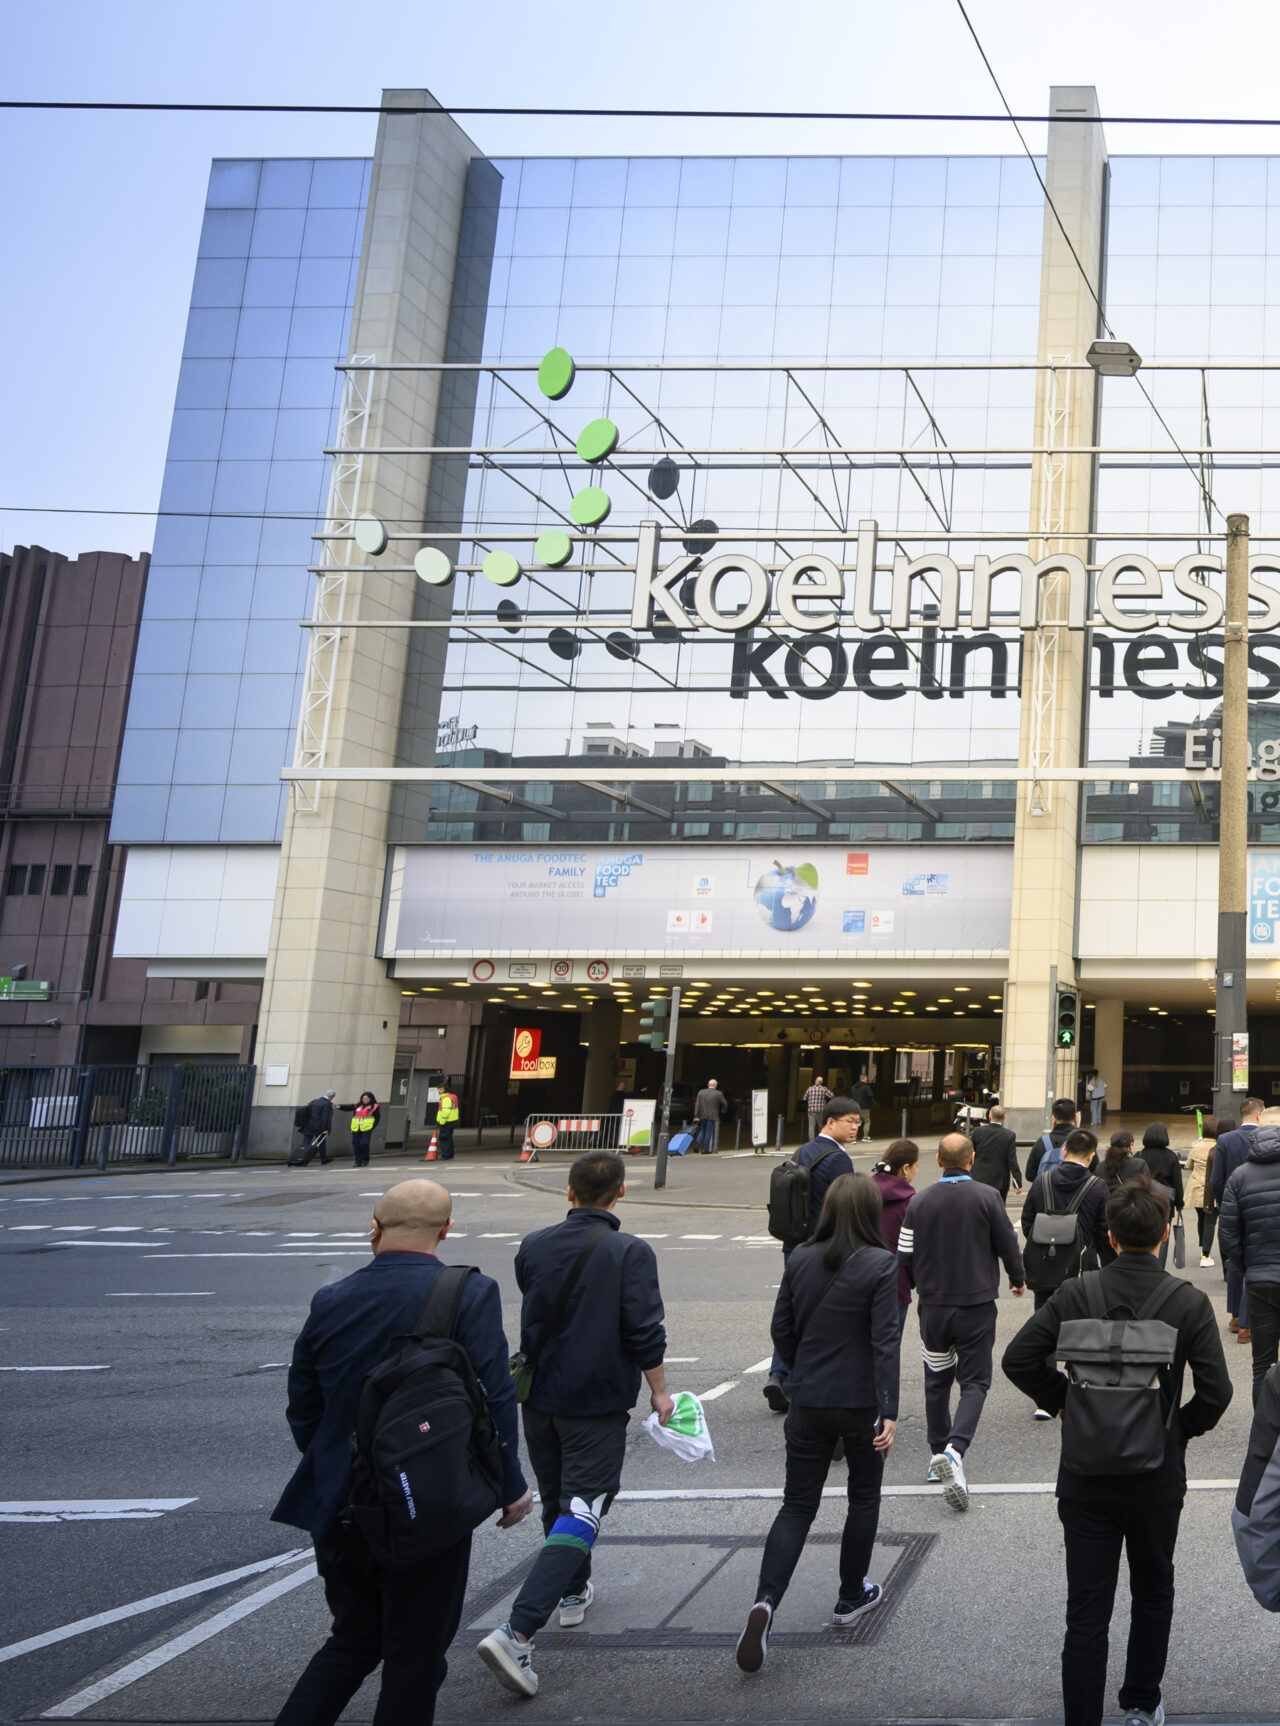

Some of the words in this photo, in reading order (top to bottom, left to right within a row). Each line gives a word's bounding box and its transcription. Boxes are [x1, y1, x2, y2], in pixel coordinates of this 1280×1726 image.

[474, 853, 495, 863] THE
[498, 853, 534, 863] ANUGA
[536, 853, 587, 864] FOODTEC
[596, 854, 641, 865] ANUGA
[548, 866, 586, 877] FAMILY
[596, 865, 630, 875] FOOD
[596, 876, 617, 886] TEC
